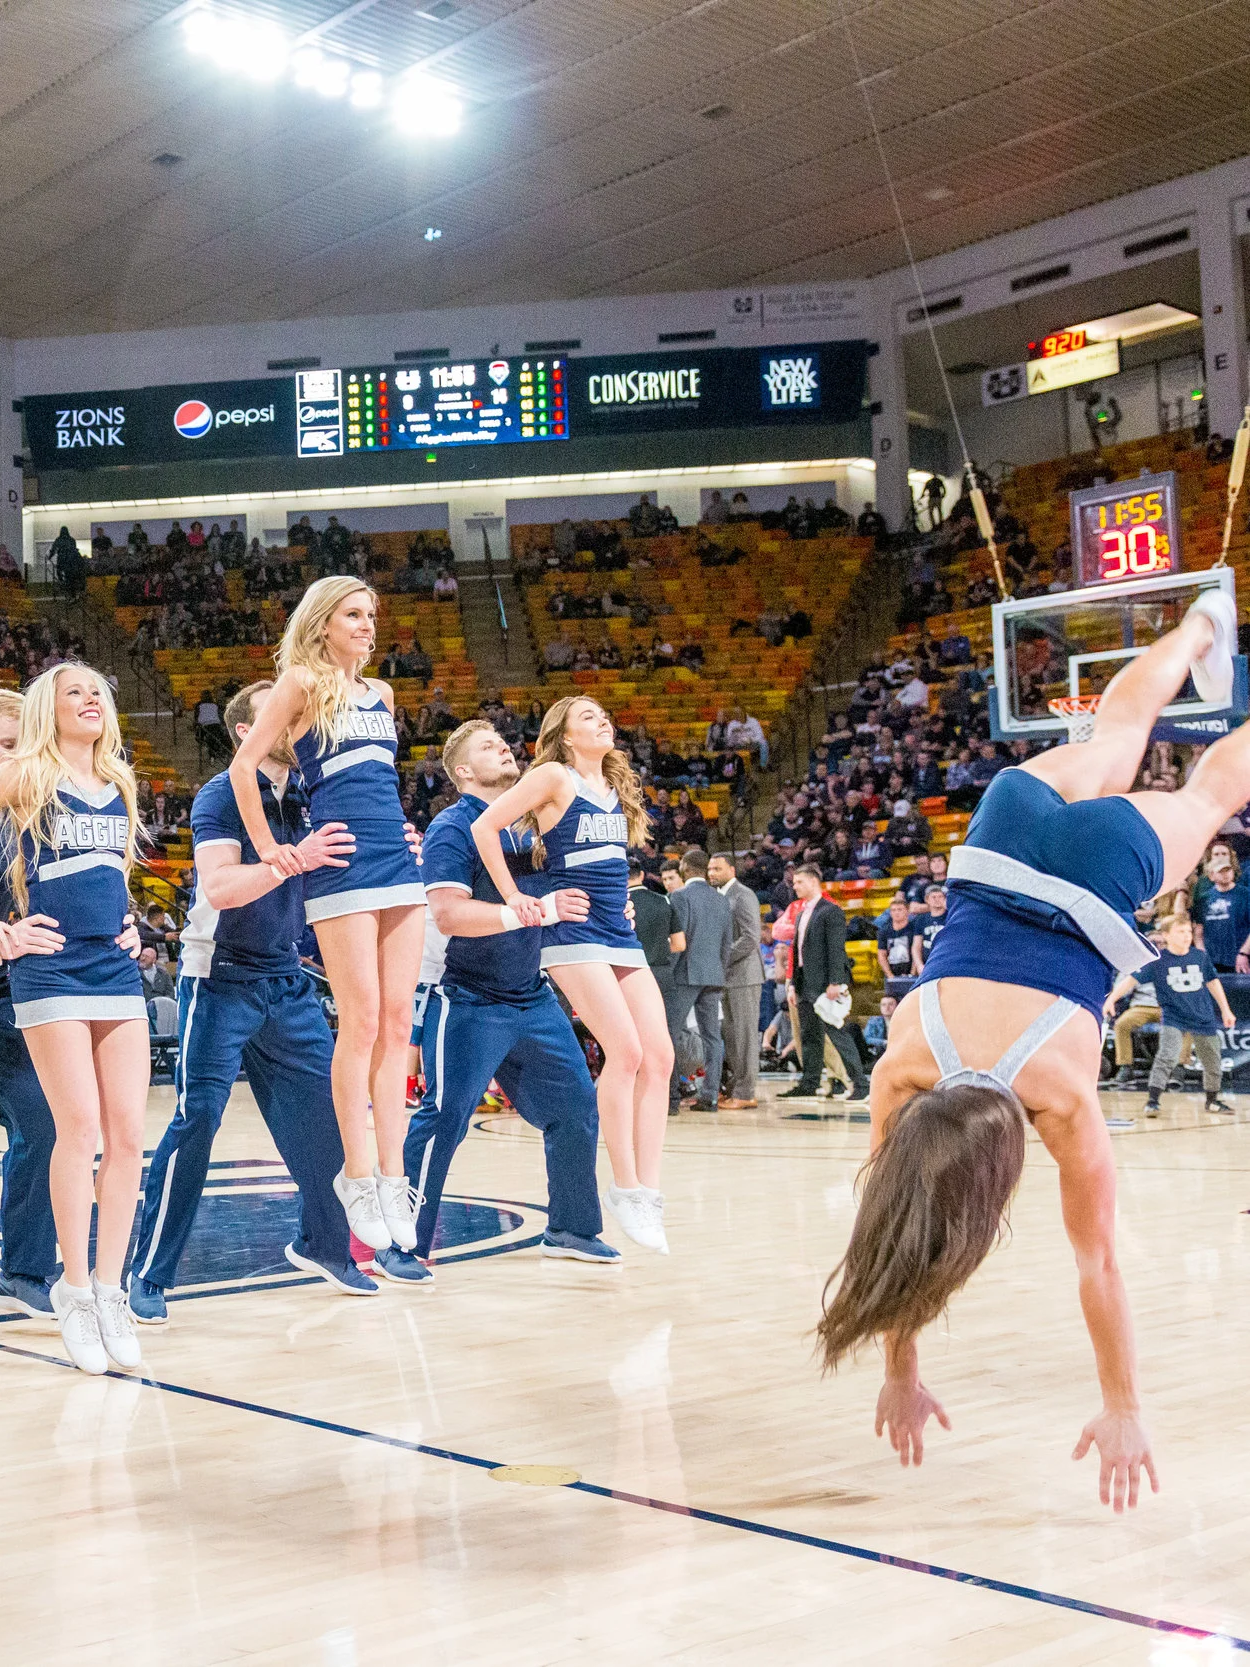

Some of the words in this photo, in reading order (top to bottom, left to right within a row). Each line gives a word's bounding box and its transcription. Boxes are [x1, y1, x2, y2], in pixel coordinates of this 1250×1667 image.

[769, 358, 813, 376] NEW
[1214, 353, 1229, 371] E
[588, 368, 701, 405] CONSERVICE
[763, 370, 819, 390] YORK
[770, 386, 814, 405] LIFE
[54, 406, 126, 428] ZIONS
[215, 404, 275, 429] pepsi
[56, 427, 126, 449] BANK
[8, 489, 18, 503] D
[1098, 493, 1163, 529] 11:55
[1100, 524, 1157, 579] 30
[51, 813, 129, 852] AGGIE
